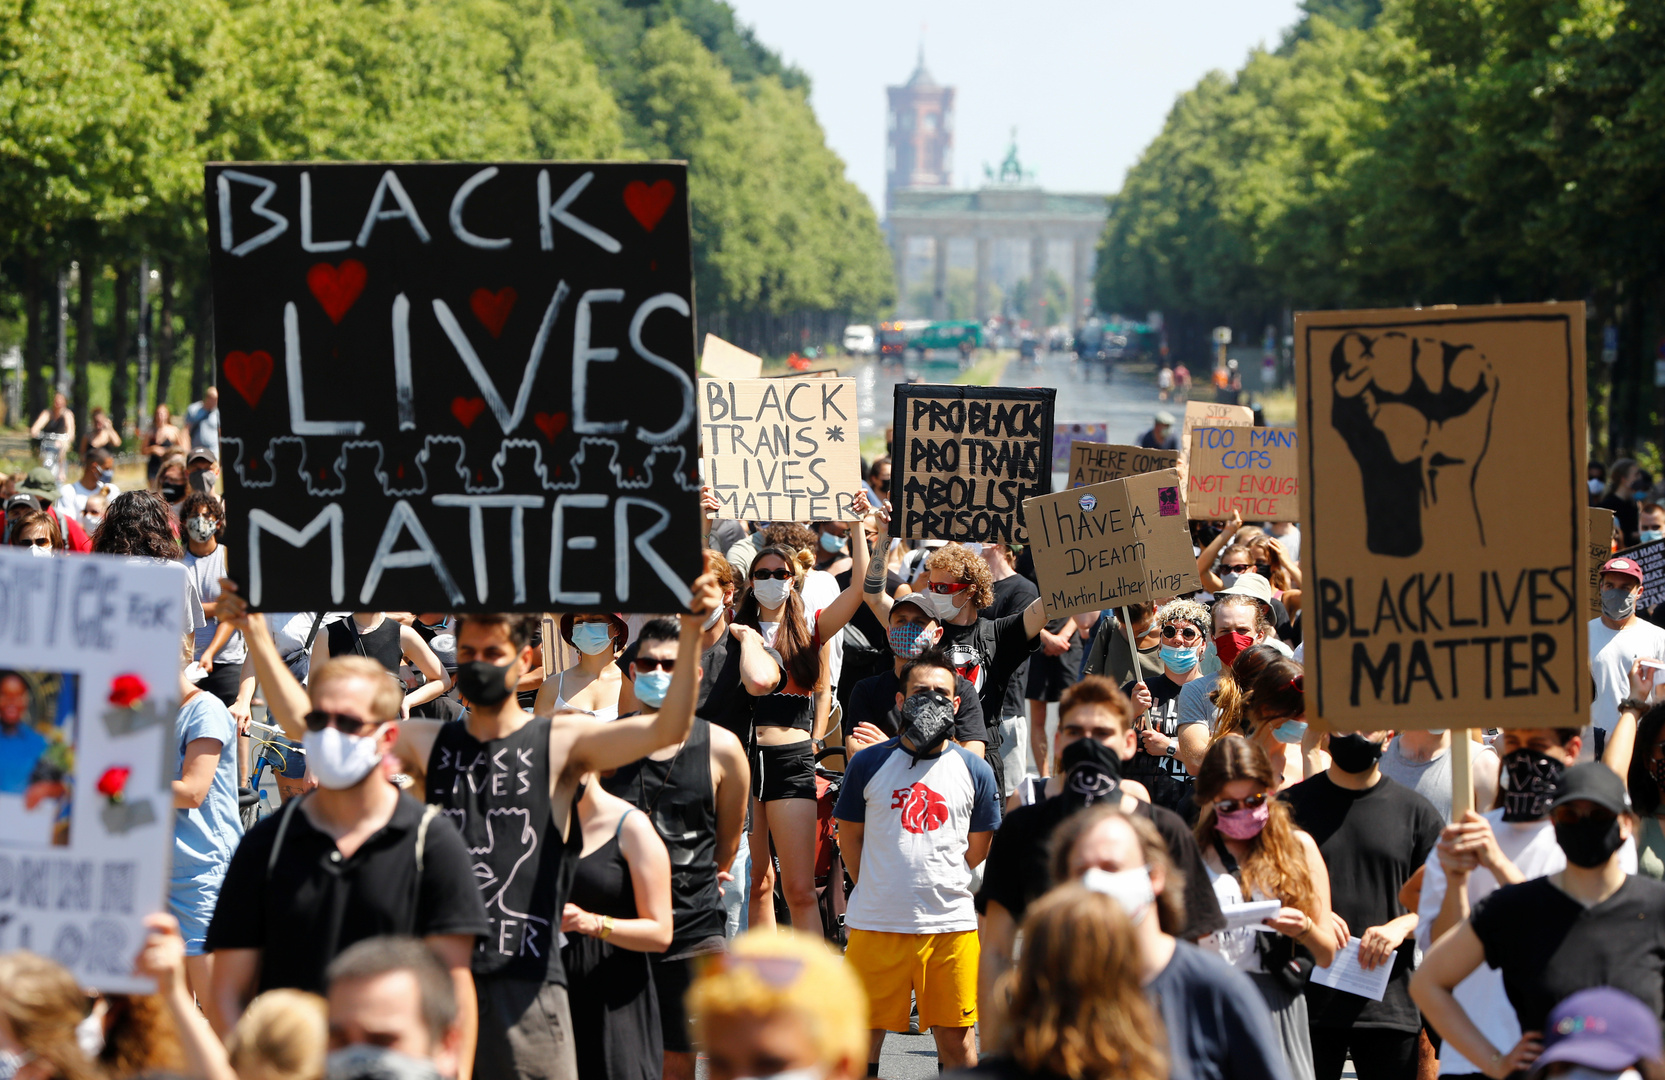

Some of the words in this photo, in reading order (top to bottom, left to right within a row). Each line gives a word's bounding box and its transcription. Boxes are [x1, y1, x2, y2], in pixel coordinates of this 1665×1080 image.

[217, 165, 622, 257] BLACK
[284, 279, 696, 443] LIVES
[706, 381, 848, 423] BLACK
[912, 399, 966, 434] PRO
[968, 401, 1043, 440] BLACK
[1206, 404, 1232, 418] STOP
[1192, 427, 1235, 449] TOO
[711, 457, 830, 496] LIVES
[910, 437, 961, 474] PRO
[961, 437, 1040, 482] TRANS
[1074, 466, 1085, 481] A
[1076, 447, 1128, 471] THERE
[1221, 450, 1272, 470] COPS
[904, 475, 1041, 513] ABOLISH
[1189, 474, 1231, 493] NOT
[714, 491, 861, 521] MATTER
[1209, 497, 1279, 517] JUSTICE
[1039, 504, 1051, 548] I
[1131, 505, 1146, 529] A
[248, 493, 696, 607] MATTER
[1099, 576, 1146, 602] Luther
[1349, 631, 1560, 708] MATTER
